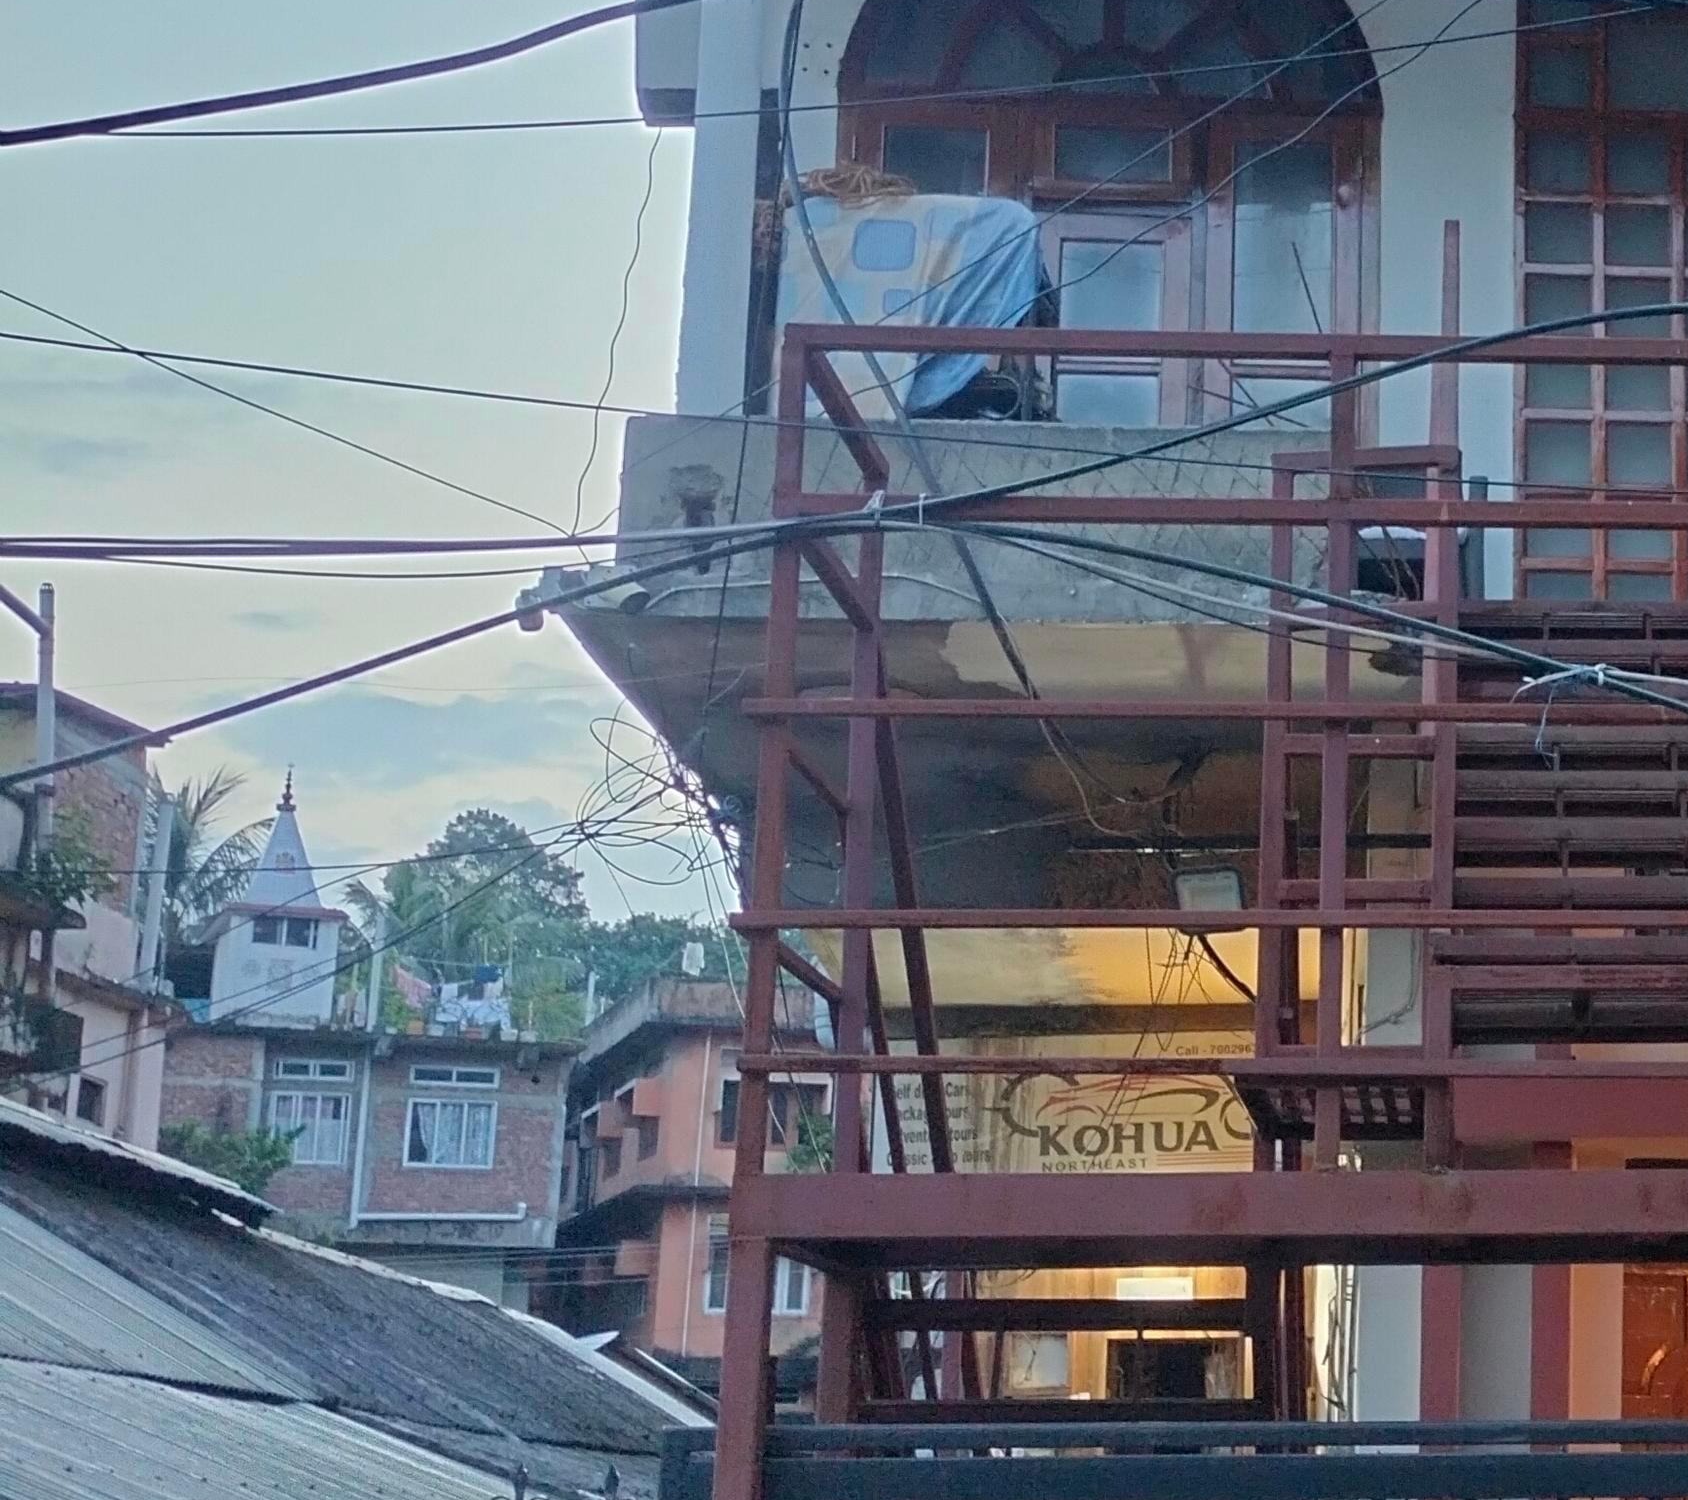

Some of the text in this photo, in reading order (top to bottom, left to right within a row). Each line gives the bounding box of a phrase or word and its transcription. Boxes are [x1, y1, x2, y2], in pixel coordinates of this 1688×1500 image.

[1175, 1045, 1199, 1056] Call
[946, 1106, 969, 1119] ours
[1037, 1120, 1220, 1157] KOHUA
[1042, 1157, 1148, 1173] NORTHEAST
